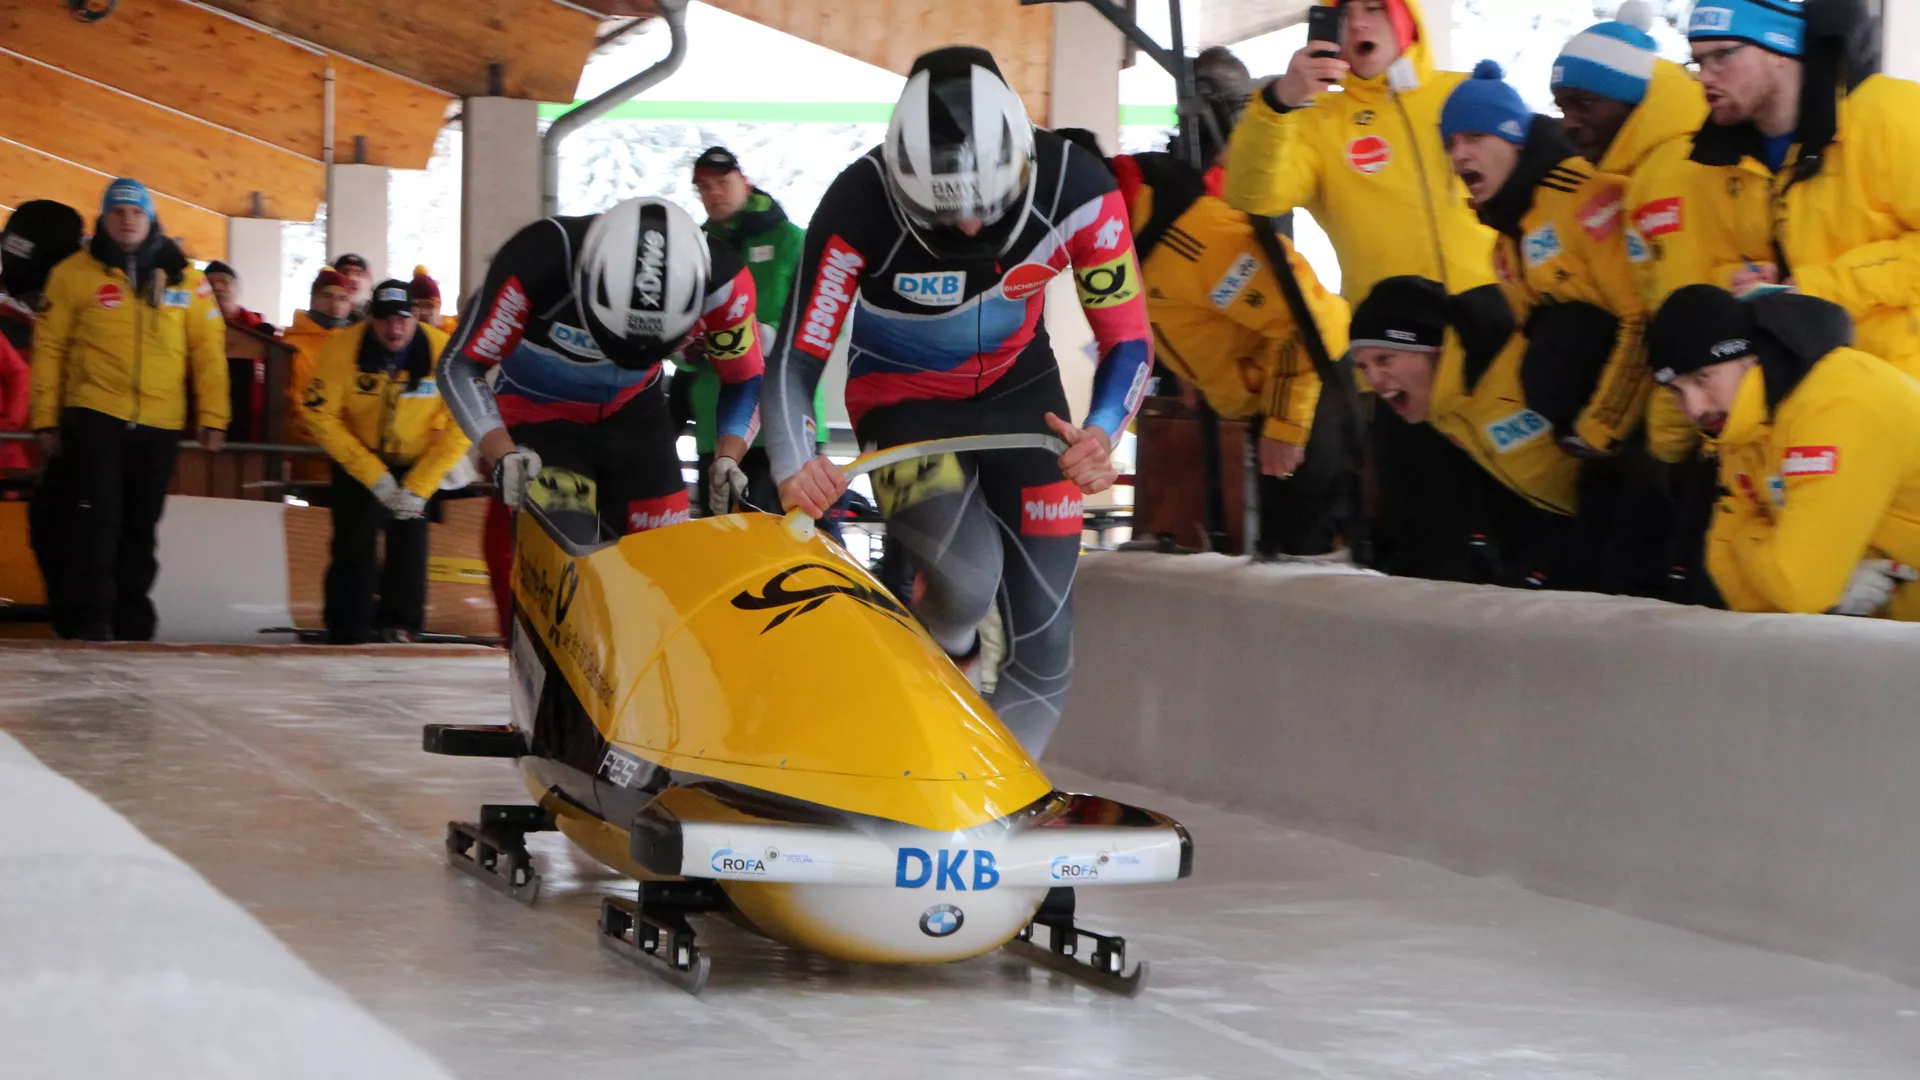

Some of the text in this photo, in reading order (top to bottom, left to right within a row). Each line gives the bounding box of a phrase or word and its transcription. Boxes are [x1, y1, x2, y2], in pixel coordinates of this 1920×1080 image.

[635, 229, 665, 308] xDrive
[898, 274, 959, 296] DKB
[803, 251, 864, 351] Nudossi
[471, 285, 528, 362] Nudossi
[597, 749, 640, 788] FES
[723, 858, 765, 872] ROFA
[895, 847, 1000, 891] DKB
[1060, 864, 1098, 877] ROFA
